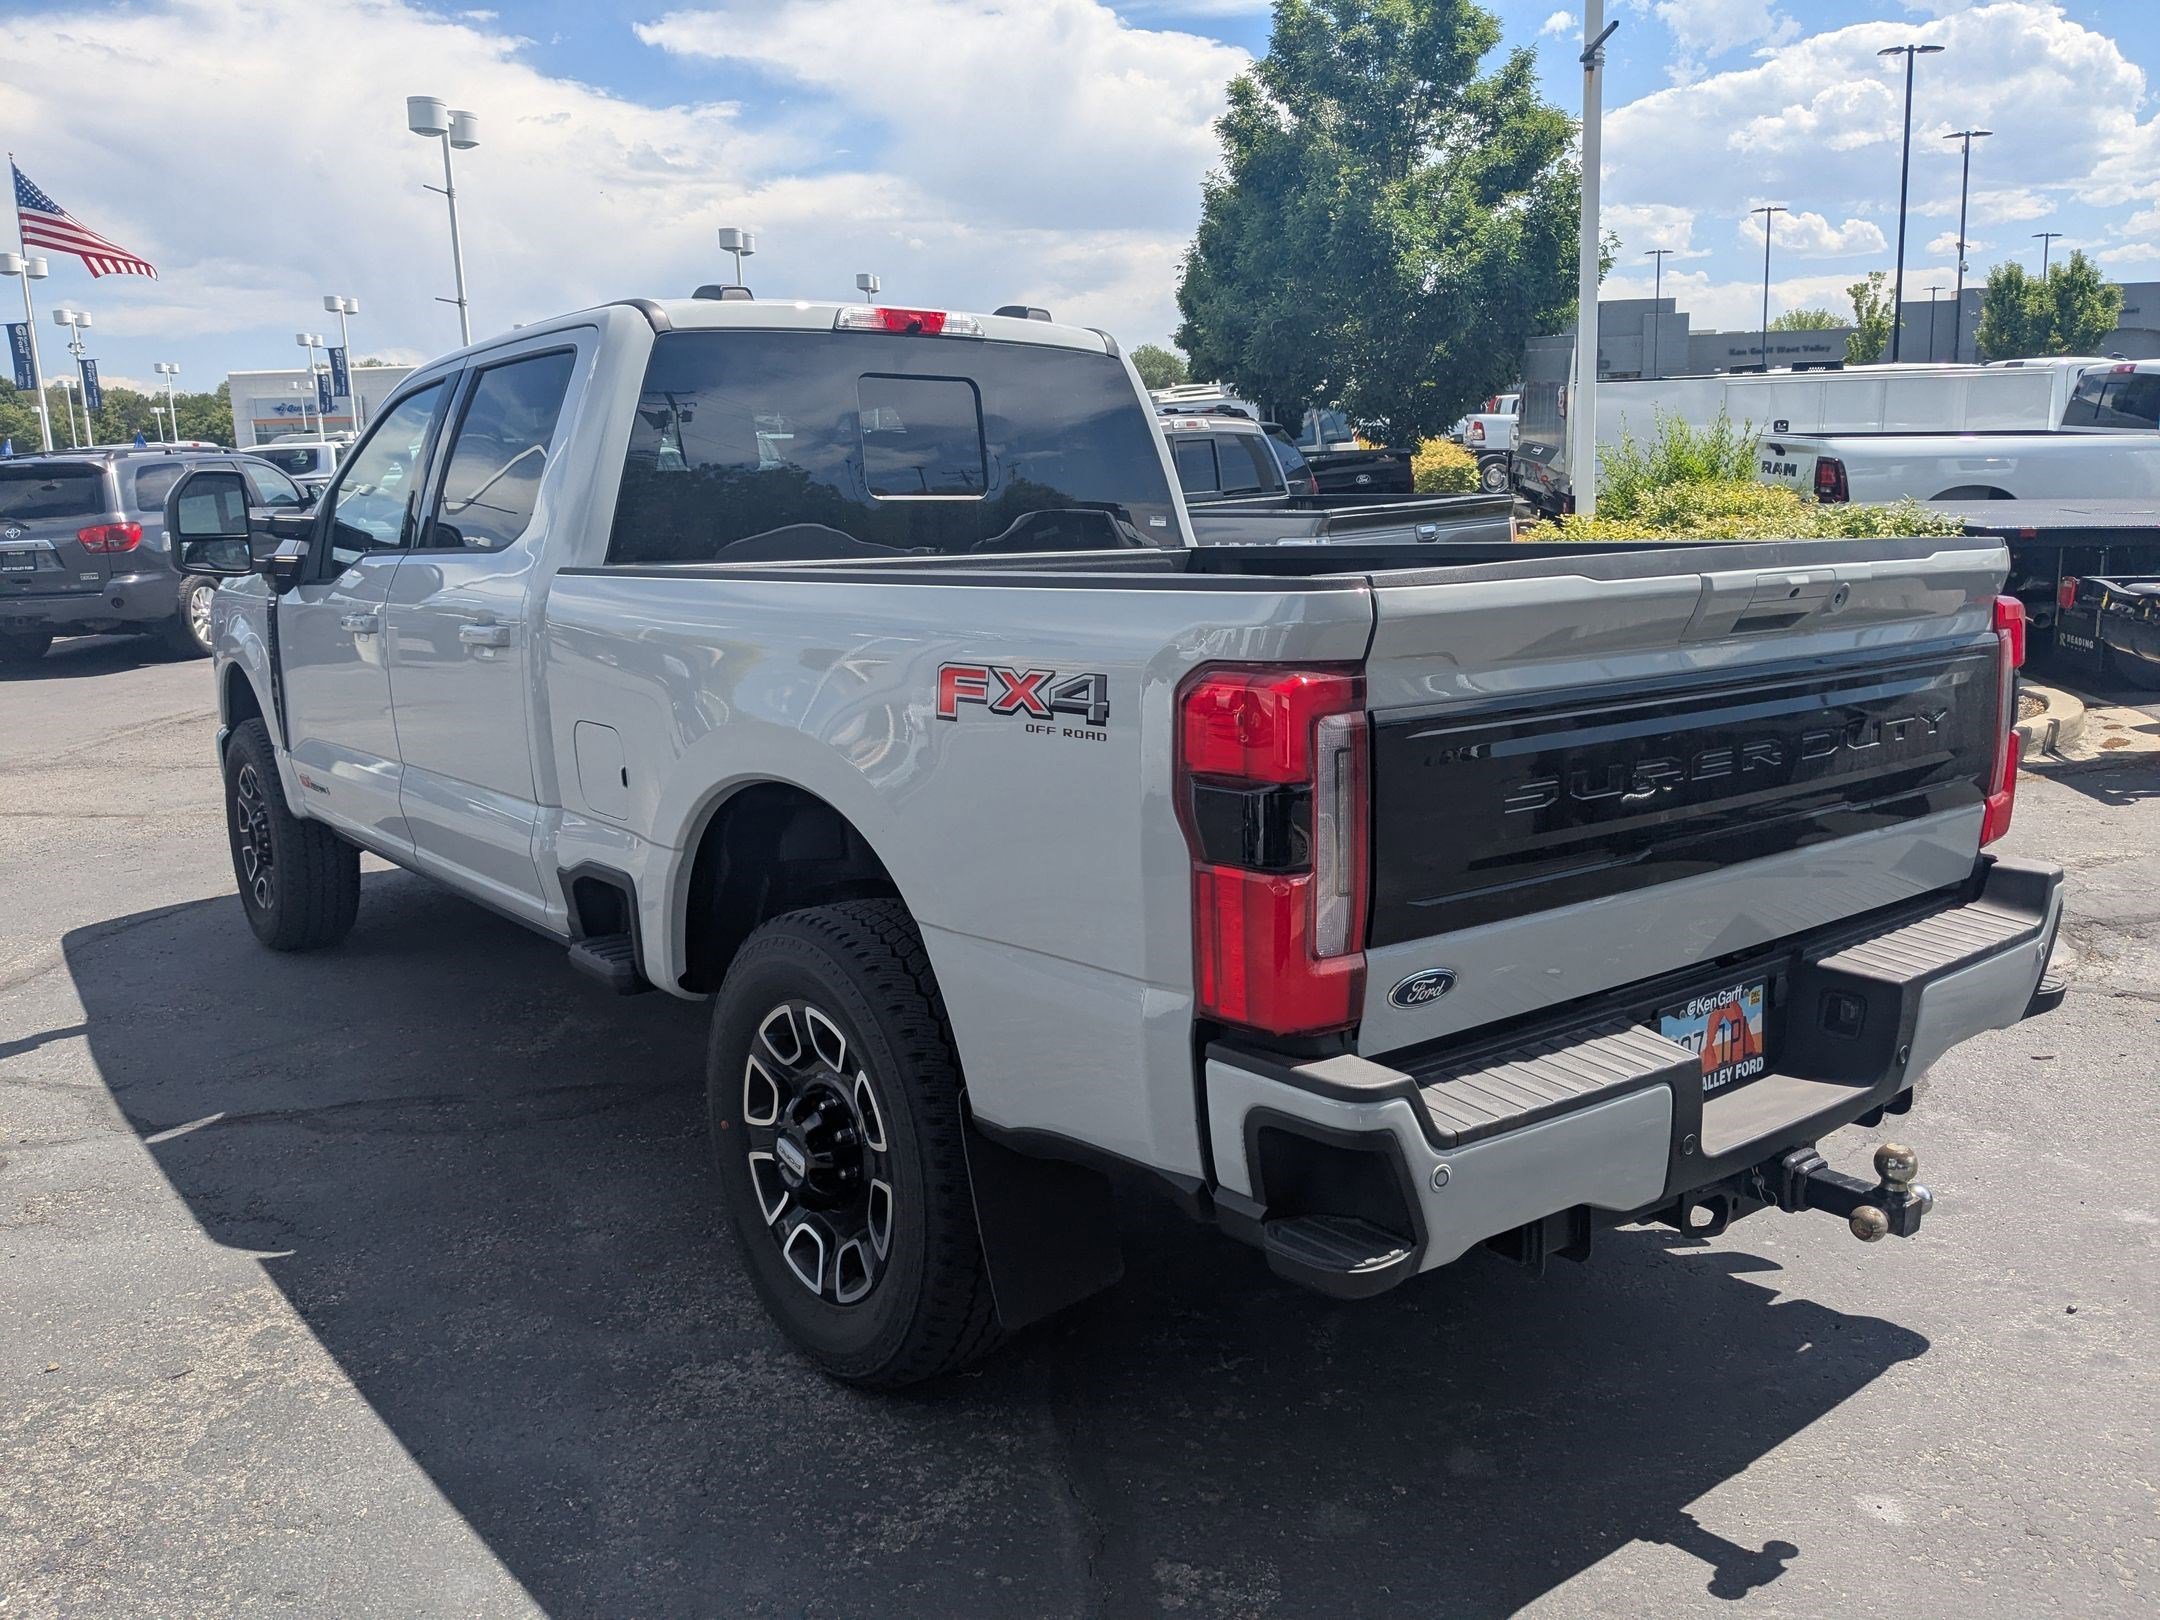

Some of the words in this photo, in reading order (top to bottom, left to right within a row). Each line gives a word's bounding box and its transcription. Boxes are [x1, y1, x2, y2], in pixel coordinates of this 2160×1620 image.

[17, 337, 25, 353] Ford
[1761, 461, 1797, 477] RAM
[936, 661, 1110, 727] FX4
[1025, 724, 1056, 735] OFF
[1063, 728, 1107, 742] ROAD
[1504, 740, 1782, 814] SUPER
[1802, 706, 1948, 760] DUTY
[1407, 977, 1446, 1003] Ford
[1697, 996, 1717, 1014] Ken
[1718, 985, 1743, 1005] Garff
[1702, 1066, 1735, 1092] ALLEY
[1735, 1056, 1764, 1080] FORD
